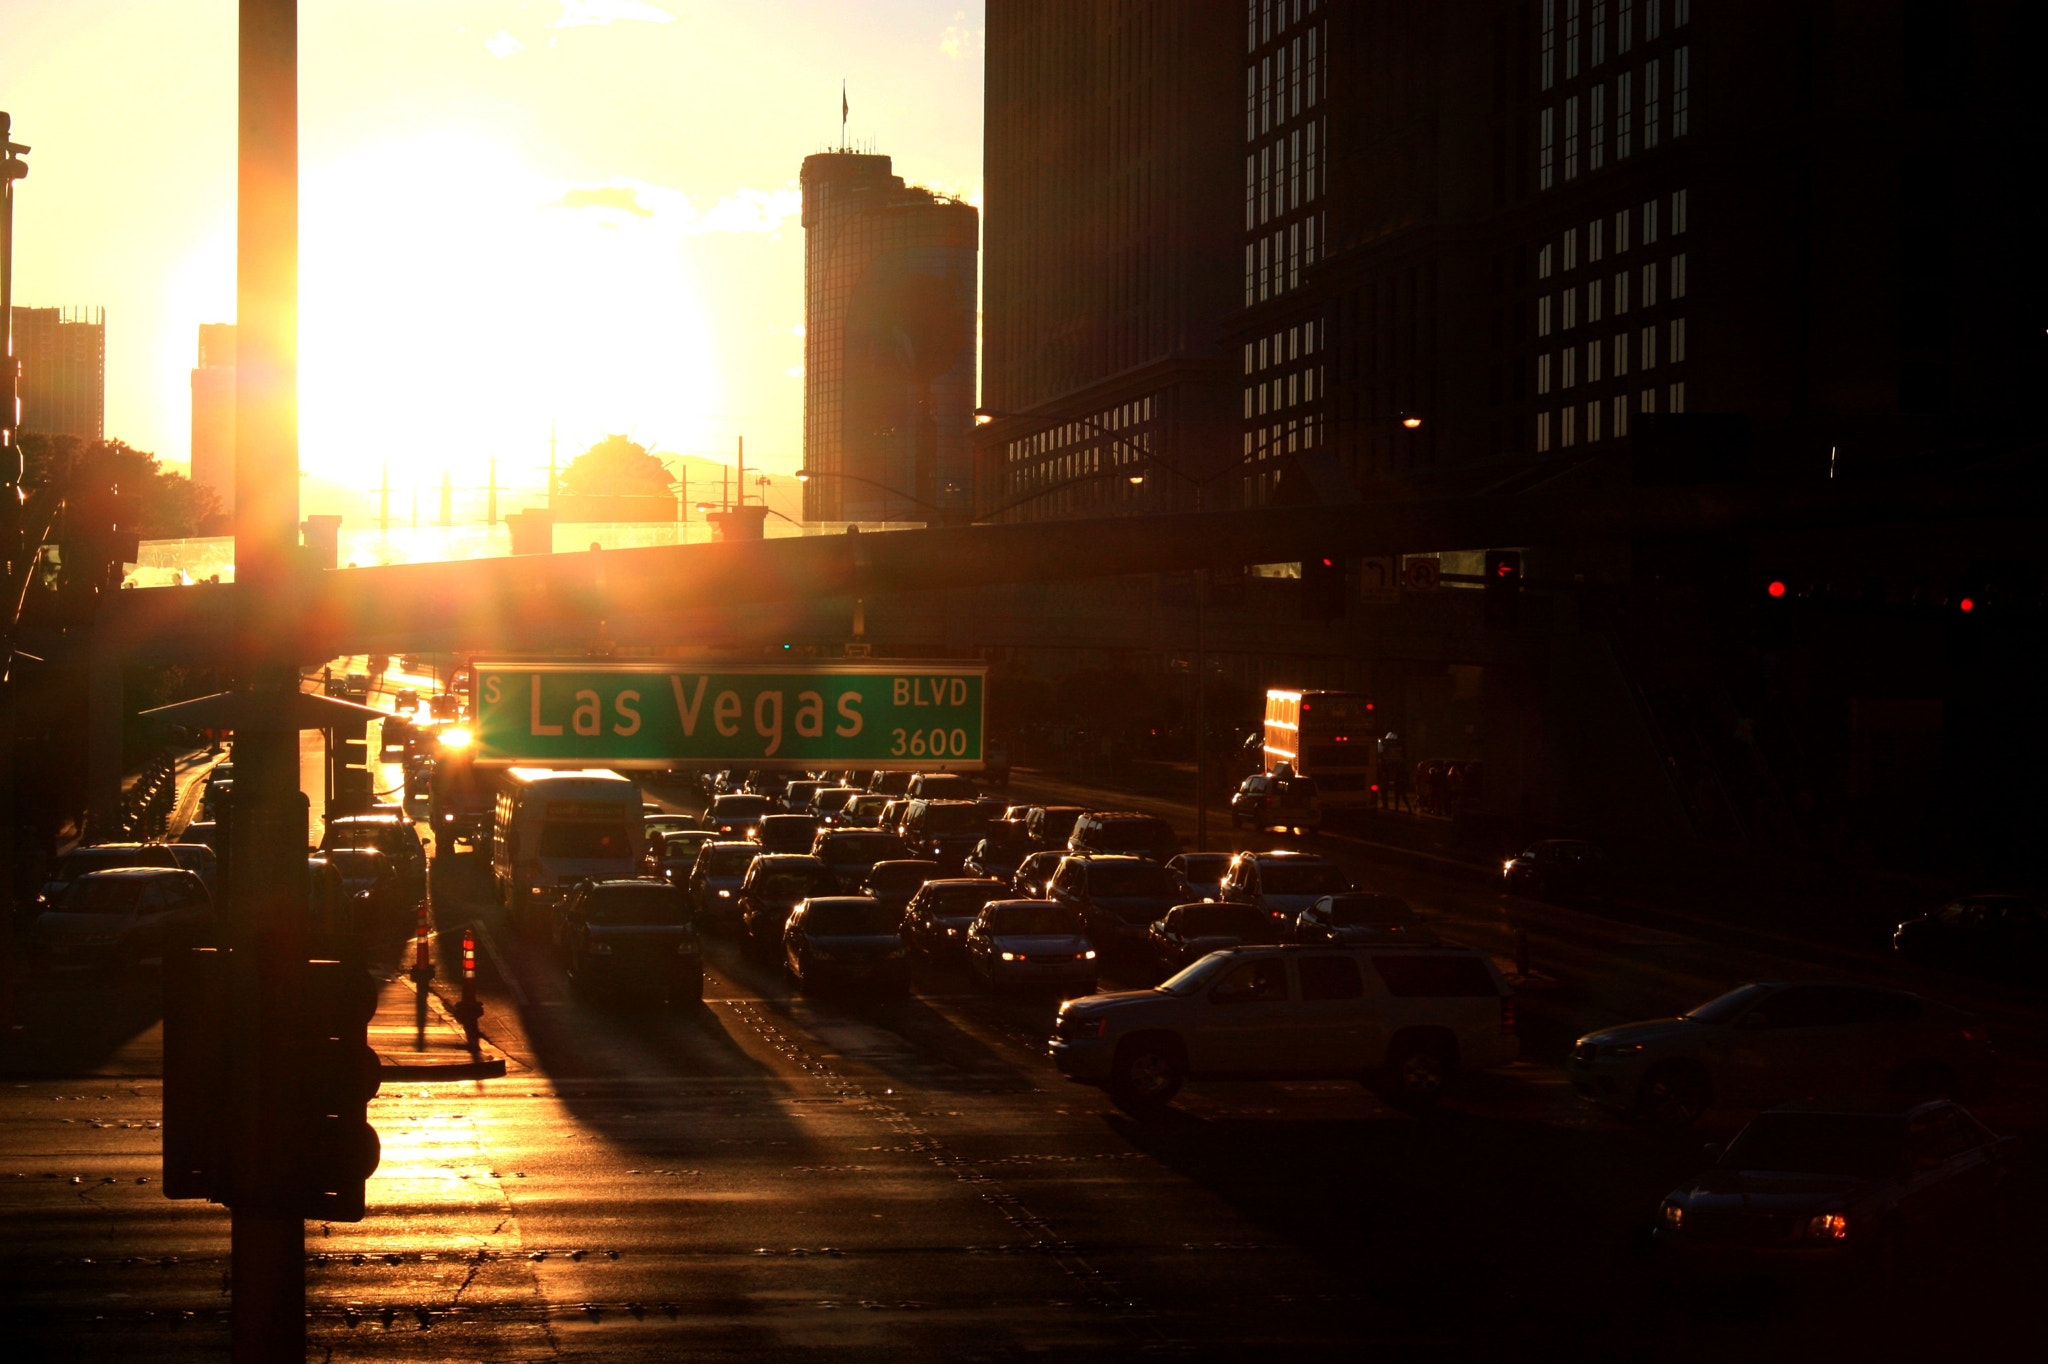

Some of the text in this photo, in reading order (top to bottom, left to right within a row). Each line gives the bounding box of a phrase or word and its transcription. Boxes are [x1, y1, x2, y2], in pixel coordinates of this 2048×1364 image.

[484, 674, 968, 757] S Las Vegas BLVD
[890, 728, 968, 756] 3600
